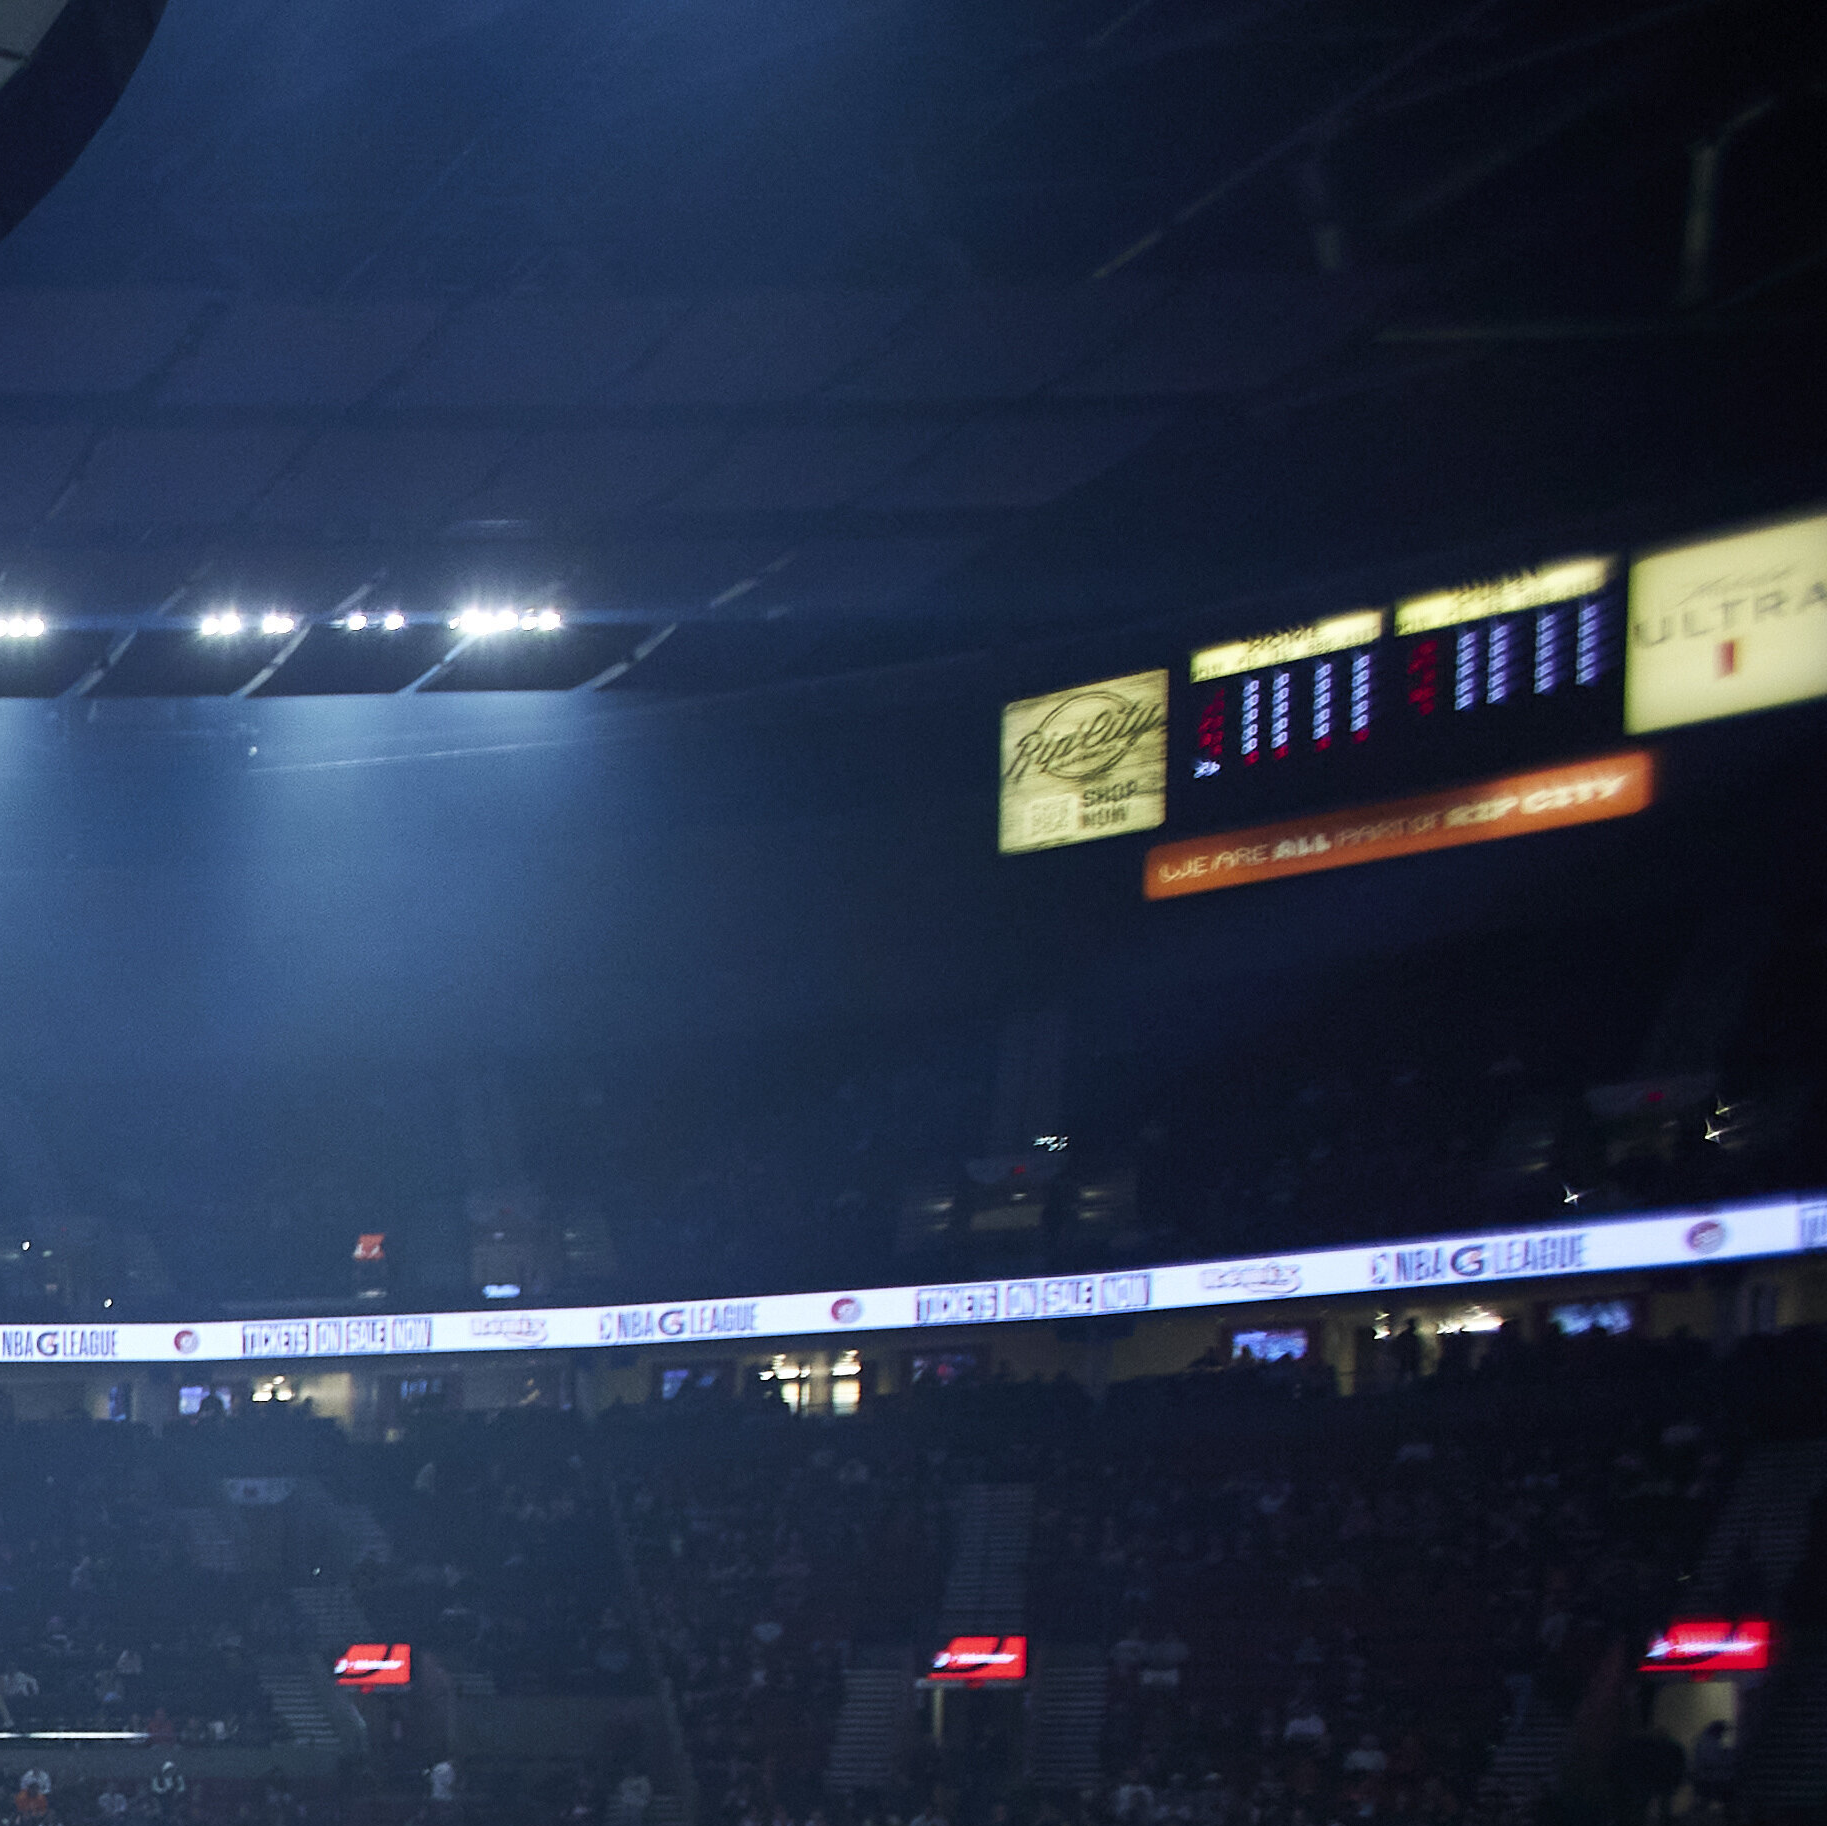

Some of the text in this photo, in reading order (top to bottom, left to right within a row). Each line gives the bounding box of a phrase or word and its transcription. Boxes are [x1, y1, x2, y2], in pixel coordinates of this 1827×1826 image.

[1450, 1244, 1487, 1277] G
[618, 1303, 759, 1339] NBA G LEAGUE
[3, 1330, 118, 1357] NBA G LEAGUE
